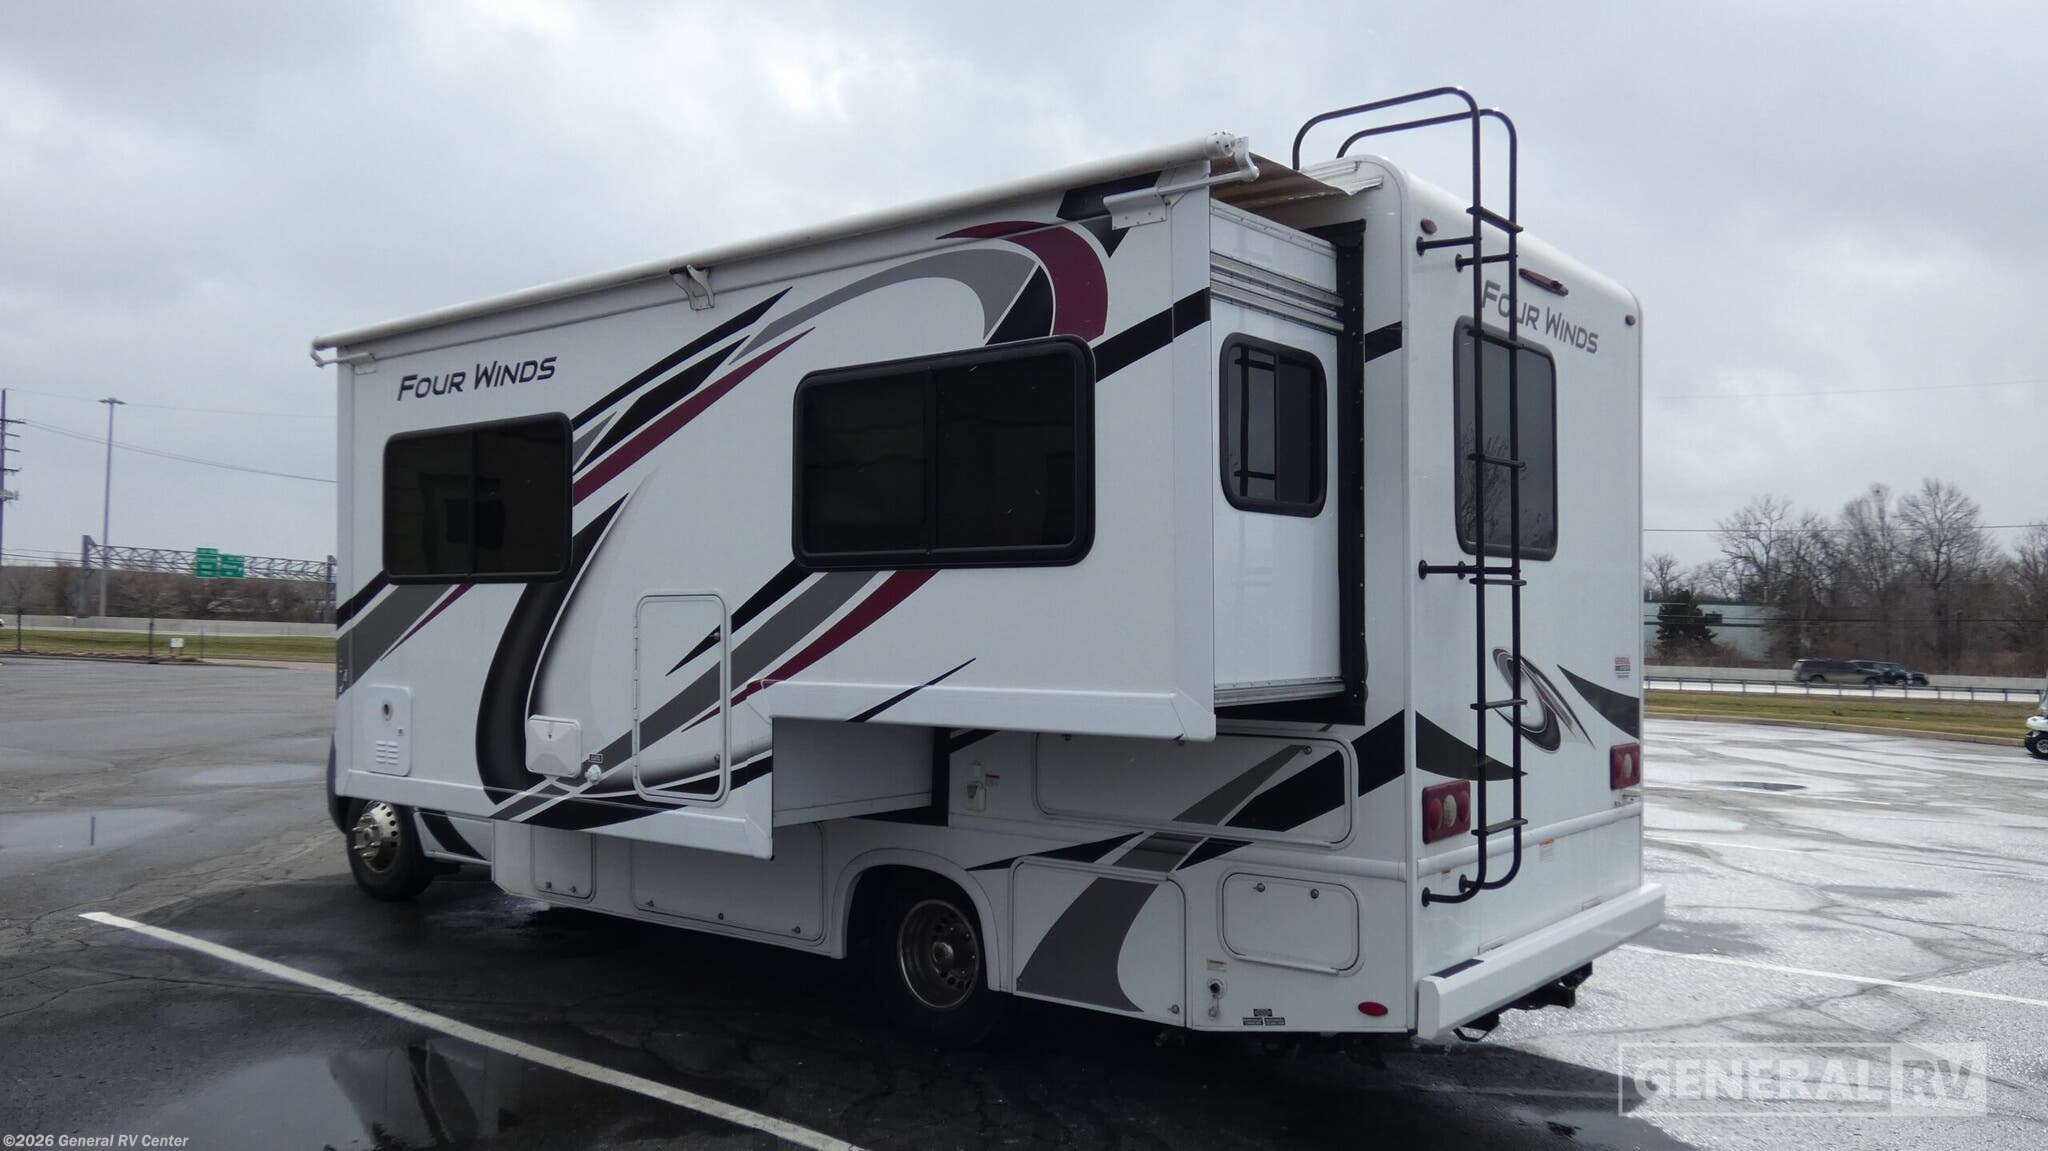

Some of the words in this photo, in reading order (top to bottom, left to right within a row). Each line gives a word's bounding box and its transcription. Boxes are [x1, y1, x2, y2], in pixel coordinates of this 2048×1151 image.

[1545, 306, 1599, 354] WINDS
[397, 371, 466, 401] FOUR
[474, 356, 557, 390] WINDS
